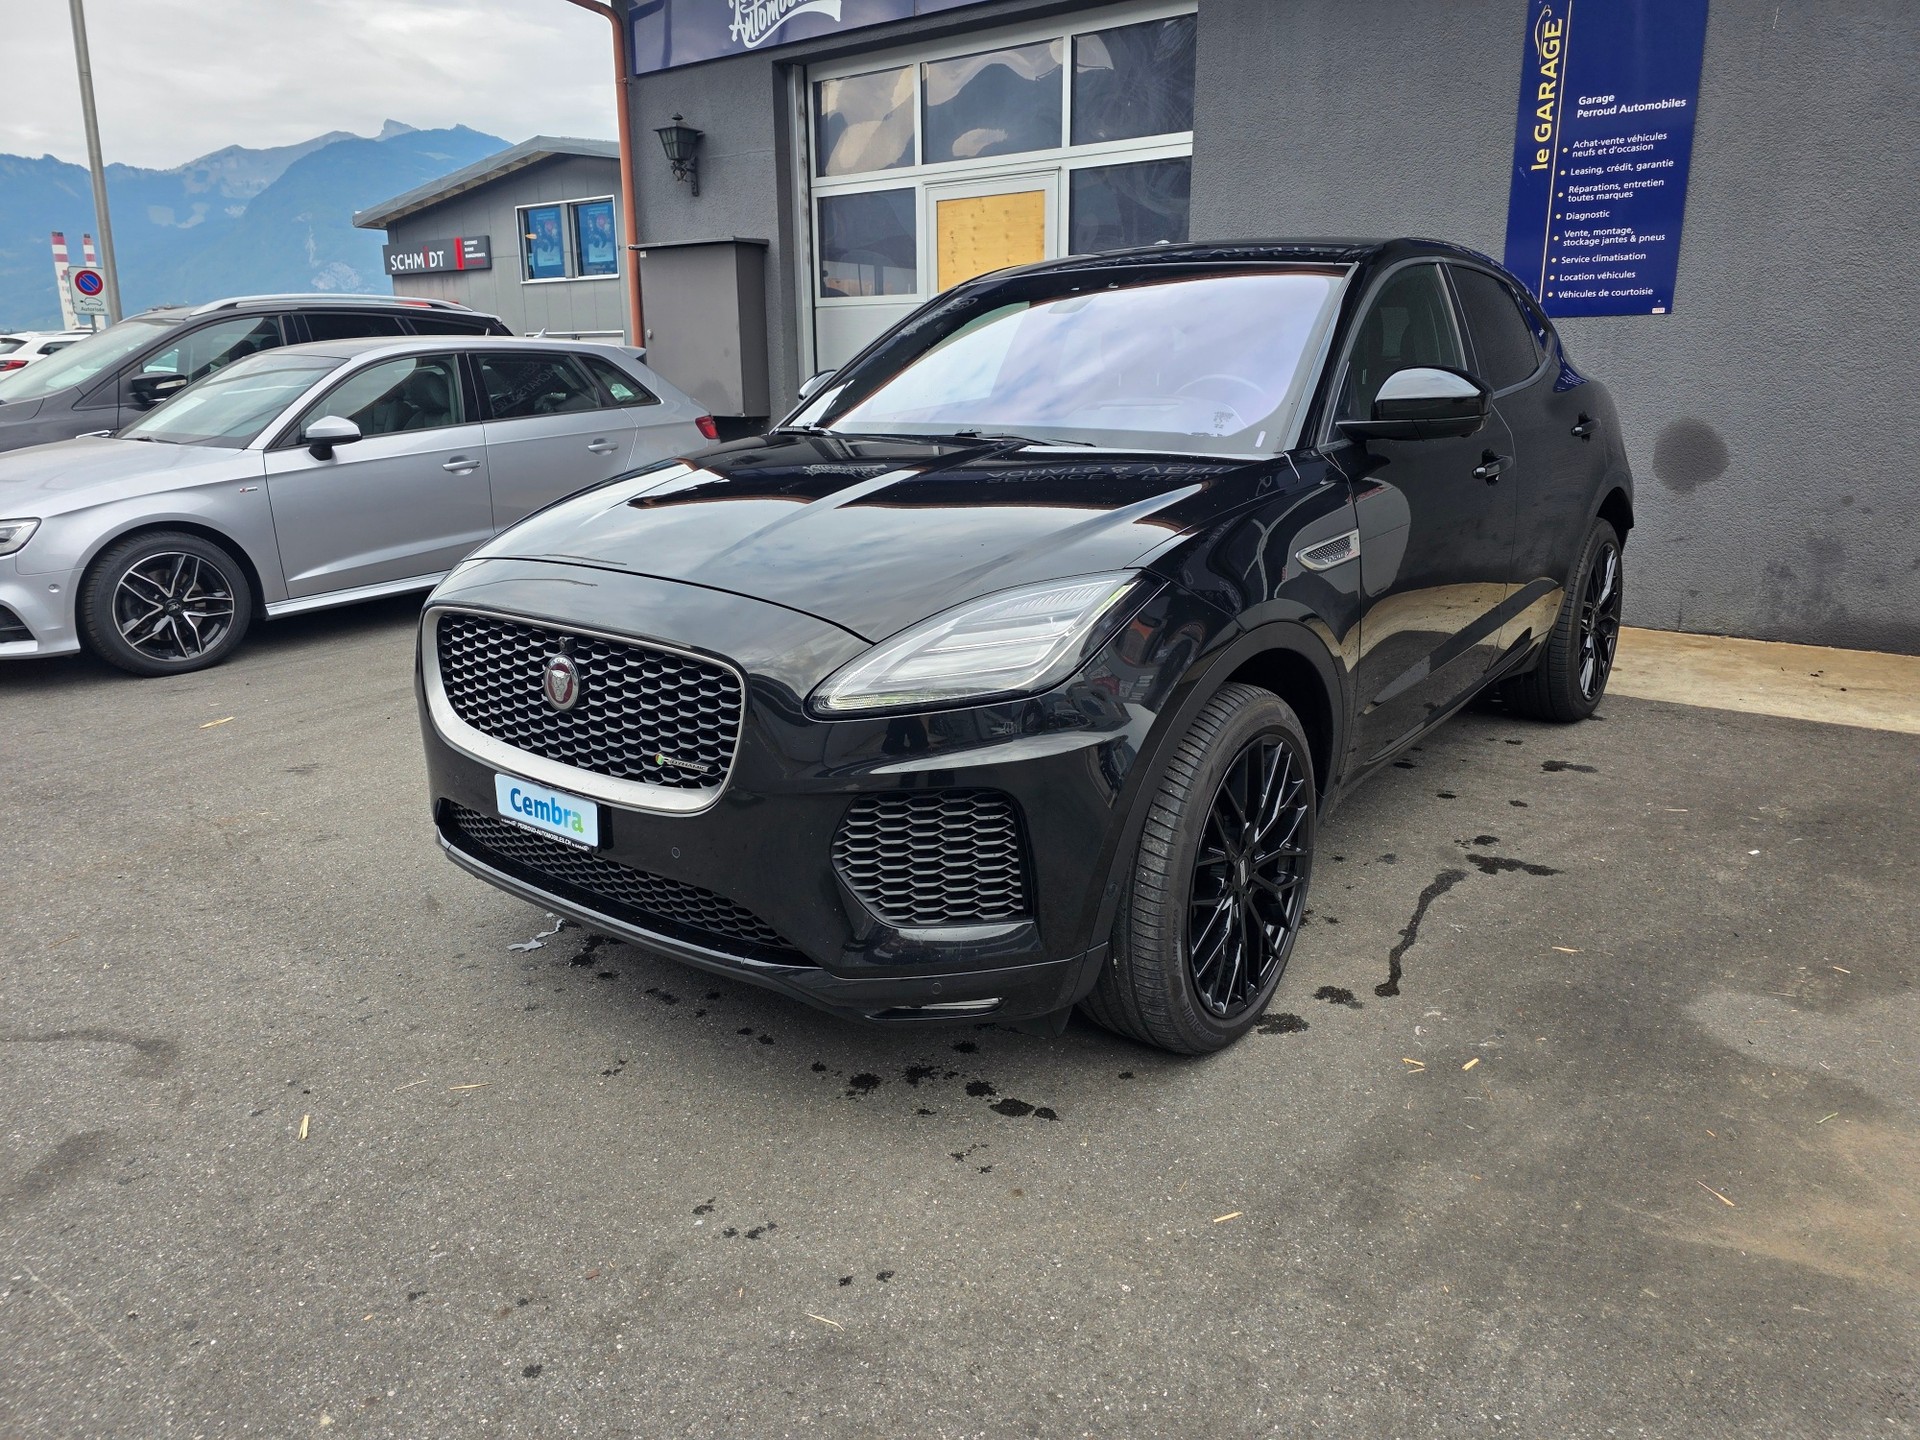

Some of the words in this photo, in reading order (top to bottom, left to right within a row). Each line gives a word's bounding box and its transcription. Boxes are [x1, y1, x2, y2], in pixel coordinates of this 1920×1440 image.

[1534, 18, 1562, 143] GARAGE
[1578, 94, 1615, 106] Garage
[1577, 105, 1617, 118] Perroud
[1619, 98, 1687, 114] Automobiles
[1573, 137, 1625, 149] Achat-vente
[1627, 132, 1667, 143] véhicules
[1531, 148, 1549, 171] le
[1572, 149, 1595, 158] neufs
[1597, 148, 1607, 156] et
[1570, 166, 1605, 176] Leasing,
[1606, 163, 1633, 174] crédit,
[1635, 159, 1674, 172] garantie
[1568, 182, 1621, 194] Réparations,
[1623, 179, 1664, 190] entretien
[1567, 192, 1594, 202] toutes
[1596, 191, 1633, 202] marques
[1565, 209, 1610, 221] Diagnostic
[1564, 229, 1590, 238] Vente,
[1593, 227, 1634, 238] montage,
[1563, 236, 1600, 247] stockage
[1600, 235, 1628, 246] jantes
[1630, 235, 1637, 243] &
[1638, 233, 1666, 243] pneus
[1561, 255, 1590, 264] Service
[1592, 252, 1646, 263] climatisation
[1559, 272, 1595, 282] Location
[1597, 270, 1636, 280] véhicules
[1558, 289, 1596, 299] Véhicules
[1598, 289, 1609, 298] de
[1611, 287, 1653, 297] courtoisie
[510, 787, 584, 833] Cembra
